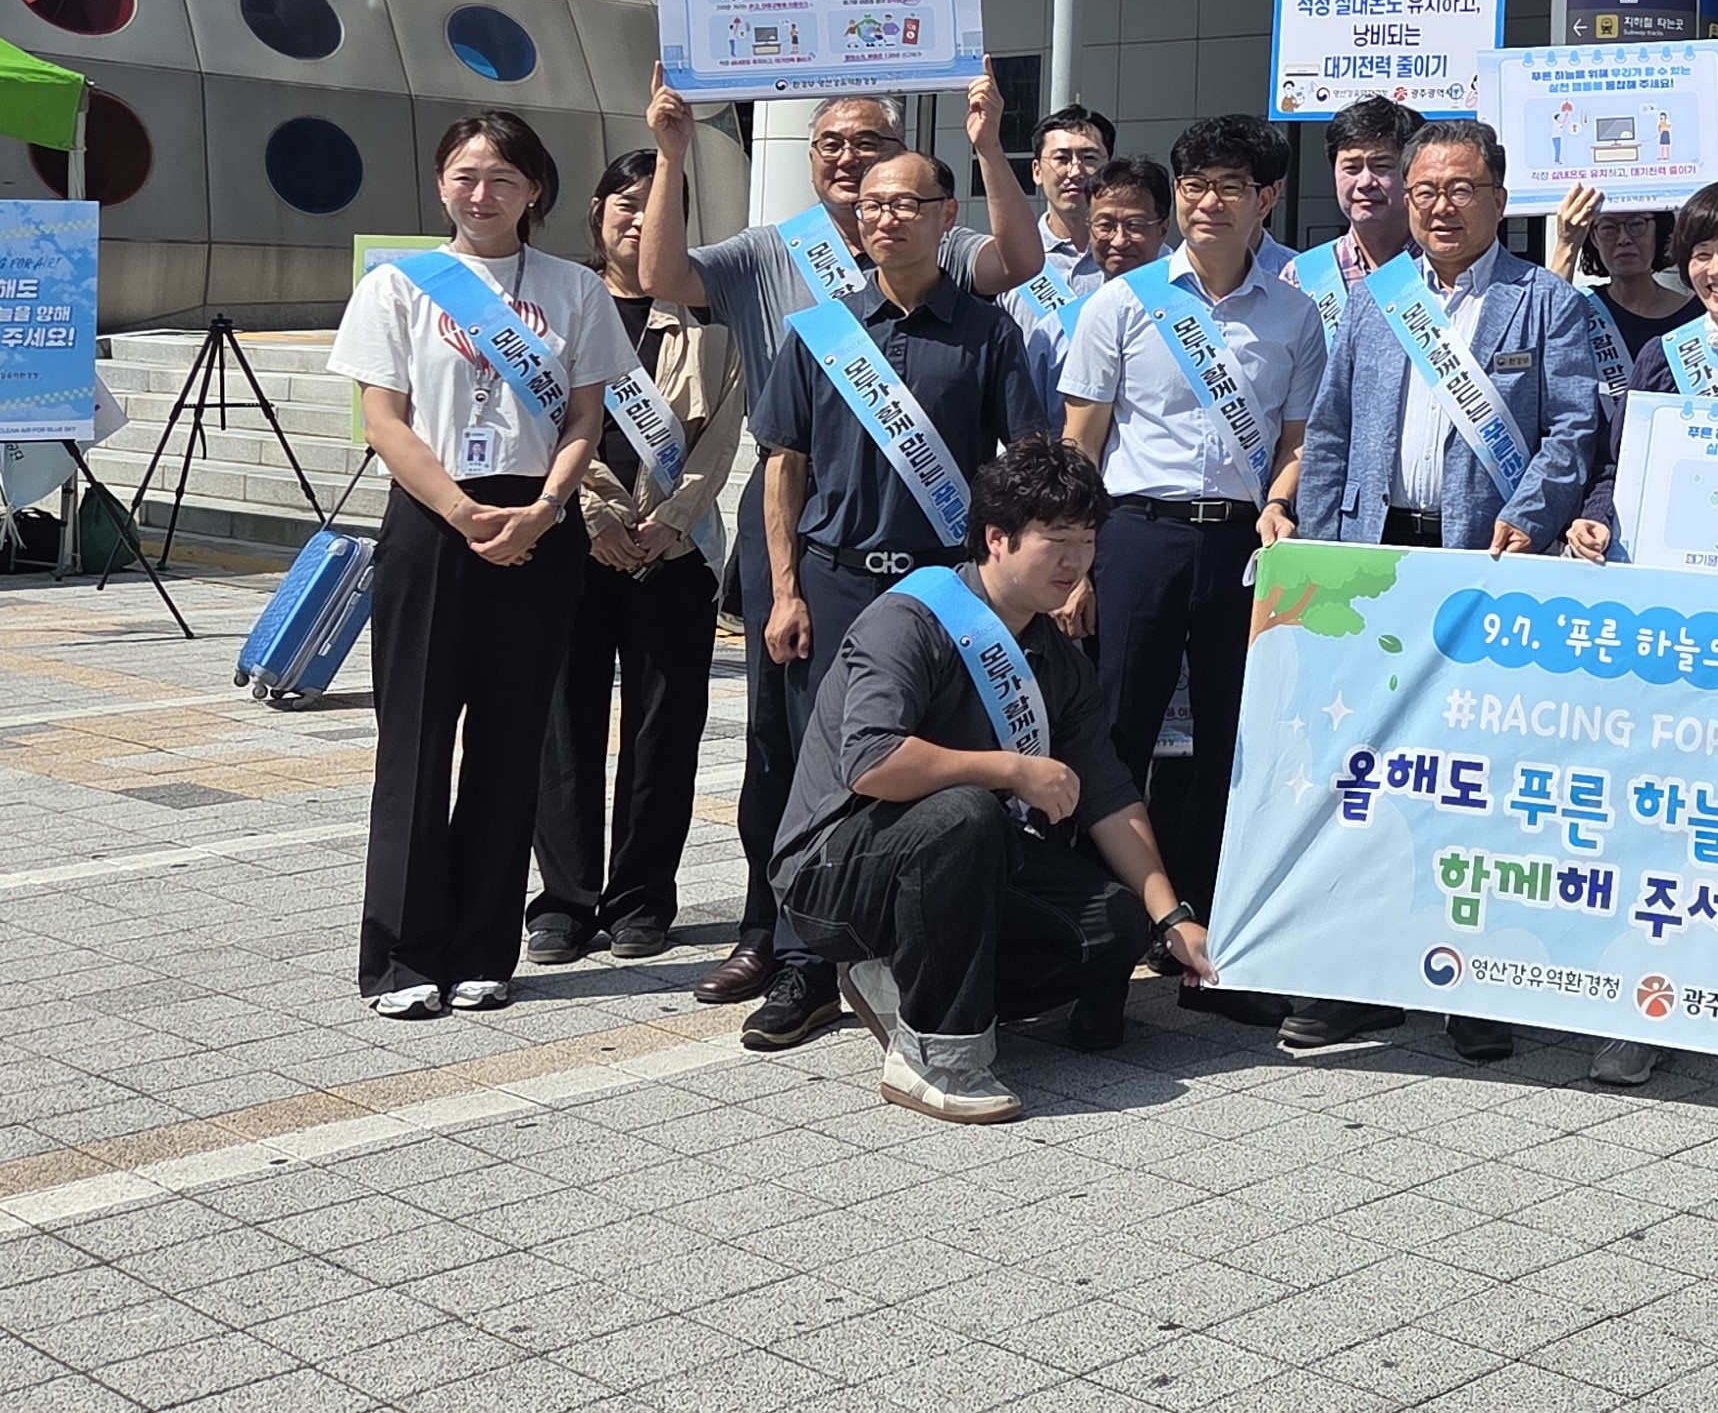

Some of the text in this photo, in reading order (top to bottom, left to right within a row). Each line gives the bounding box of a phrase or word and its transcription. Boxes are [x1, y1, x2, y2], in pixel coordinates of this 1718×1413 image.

[1352, 23, 1422, 48] 낭비되는
[1623, 16, 1684, 31] 지하철 타는곳
[1323, 53, 1448, 79] 대기전력 줄이기
[1531, 65, 1691, 82] 푸른 하늘을 위해 우리가 할 수 있는
[1548, 82, 1570, 93] 실천
[1639, 78, 1674, 90] 주세요!
[1531, 165, 1697, 181] 적정 실내온도 유지하고, 대기전력 줄이기
[10, 256, 34, 270] FOR
[33, 256, 62, 270] AIR!
[806, 241, 847, 289] 모두가
[36, 305, 71, 322] 향해
[1, 326, 76, 348] 주세요!
[1590, 334, 1619, 363] 함께
[489, 326, 543, 378] 모두가
[527, 369, 564, 408] 함께
[1401, 301, 1493, 425] 모두가 함께 만드는
[1678, 336, 1714, 388] 모두가
[1170, 315, 1217, 368] 모두가
[1200, 361, 1237, 402] 함께
[1219, 394, 1264, 451] 만드는
[46, 425, 63, 433] BLUE
[64, 425, 77, 433] SKY
[625, 398, 672, 448] 만드는
[843, 355, 891, 407] 모두가
[874, 400, 916, 440] 함께
[899, 431, 946, 488] 만드는
[1687, 425, 1713, 440] 푸른
[1684, 552, 1718, 568] 폐기물
[1482, 613, 1541, 650] 9.7.
[978, 641, 1022, 701] 모두가
[1001, 694, 1036, 737] 함께
[1442, 688, 1636, 748] #RACING
[1335, 750, 1489, 823] 올해도
[1509, 766, 1610, 850] 푸른
[1438, 851, 1616, 928] 함께해
[1470, 958, 1621, 1000] 영산강유역환경청
